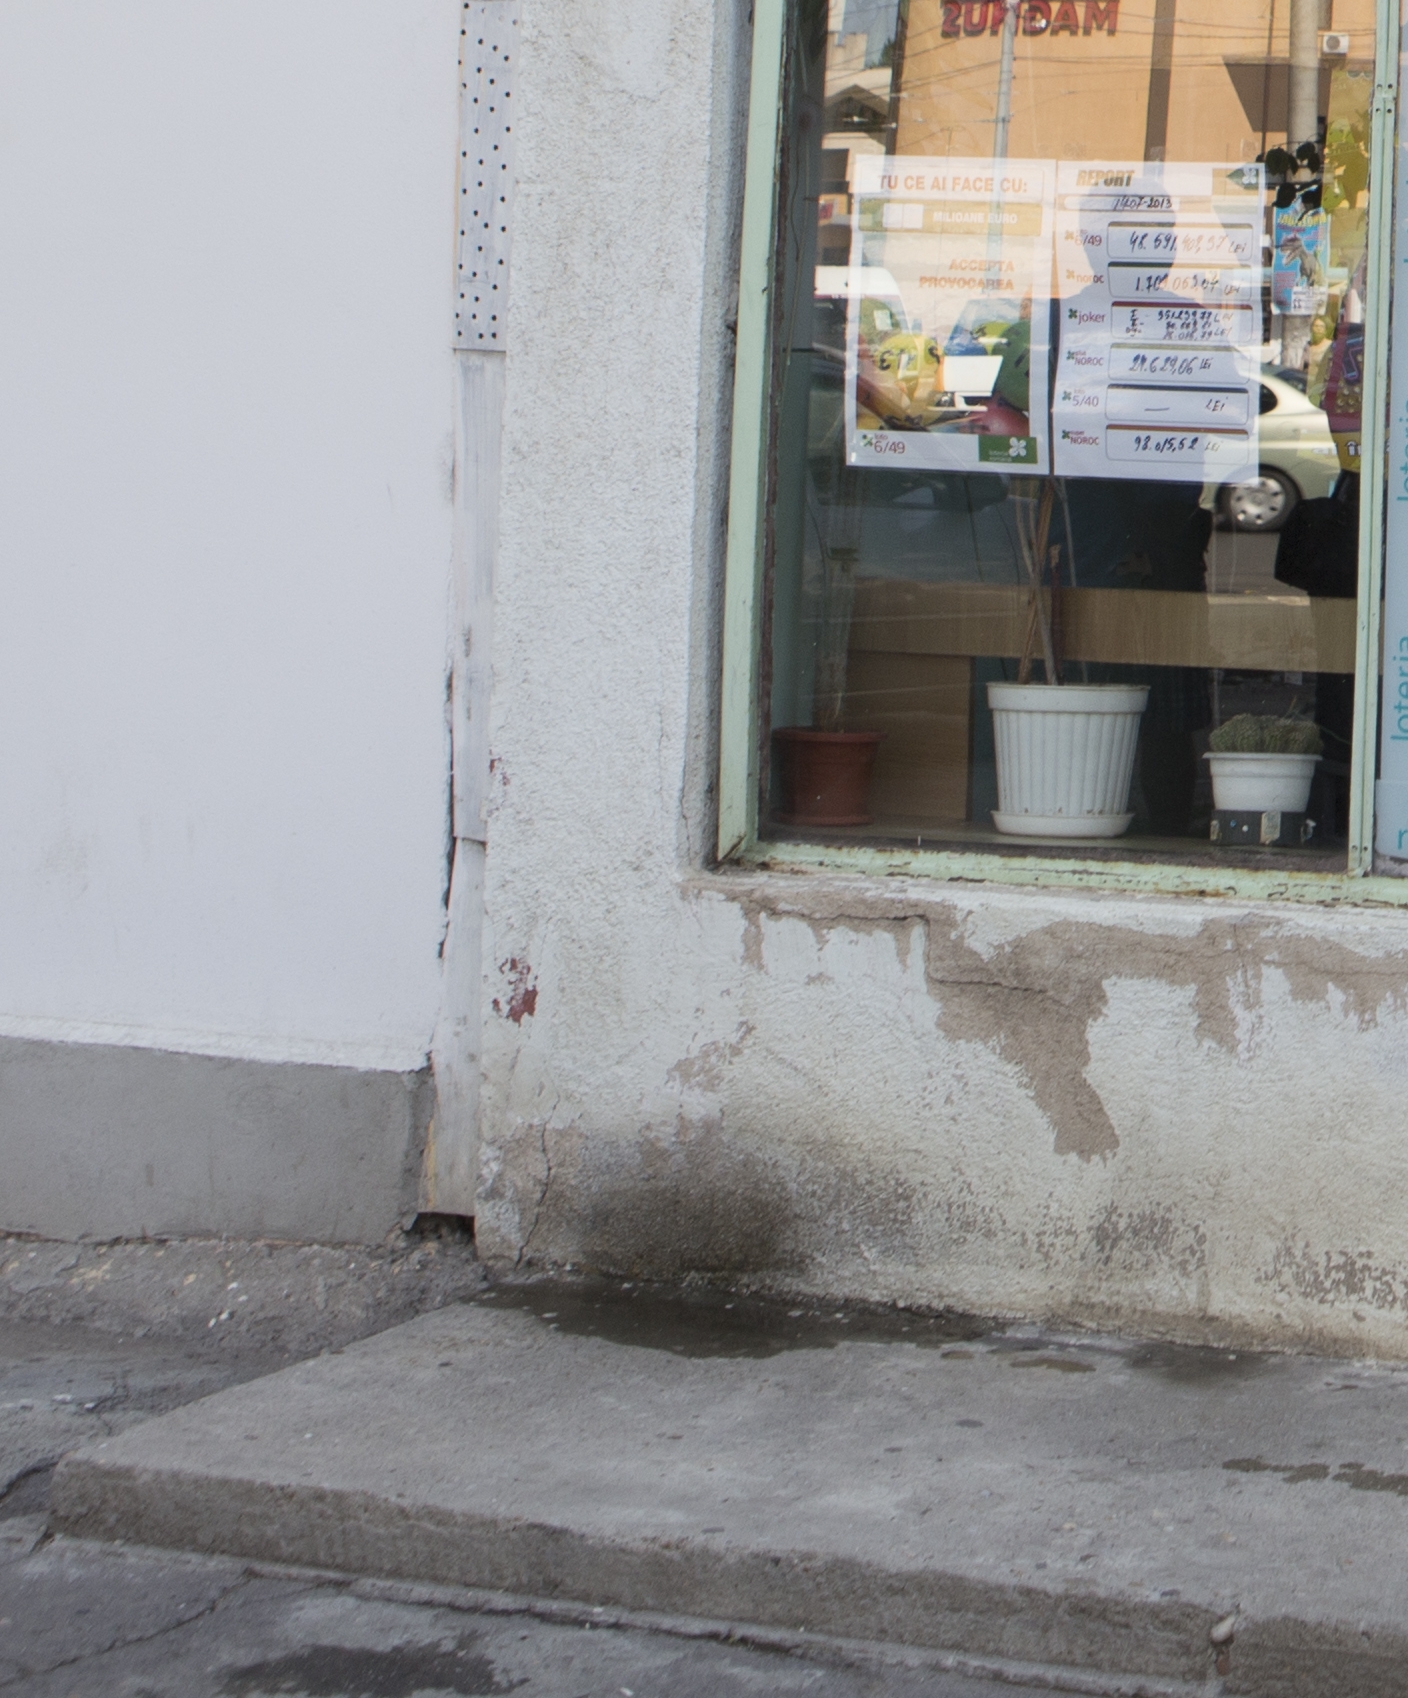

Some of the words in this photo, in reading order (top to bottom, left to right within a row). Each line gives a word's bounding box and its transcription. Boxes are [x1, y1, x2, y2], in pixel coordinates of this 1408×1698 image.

[879, 175, 899, 190] TU
[904, 176, 925, 190] CE
[931, 176, 946, 191] AI
[952, 177, 993, 192] FACE
[1000, 178, 1028, 193] CU:
[1076, 169, 1135, 187] REPORT
[933, 212, 984, 223] MILIOANE
[1074, 232, 1102, 246] 6/49
[949, 259, 1015, 272] ACCEPTA
[919, 276, 1014, 291] PROVOCAREA
[1076, 274, 1104, 285] noroc
[1078, 311, 1107, 325] joker
[1074, 358, 1104, 366] NOROC
[1072, 395, 1099, 407] 5/40
[873, 440, 907, 455] 6/49
[1070, 436, 1100, 446] NOROC
